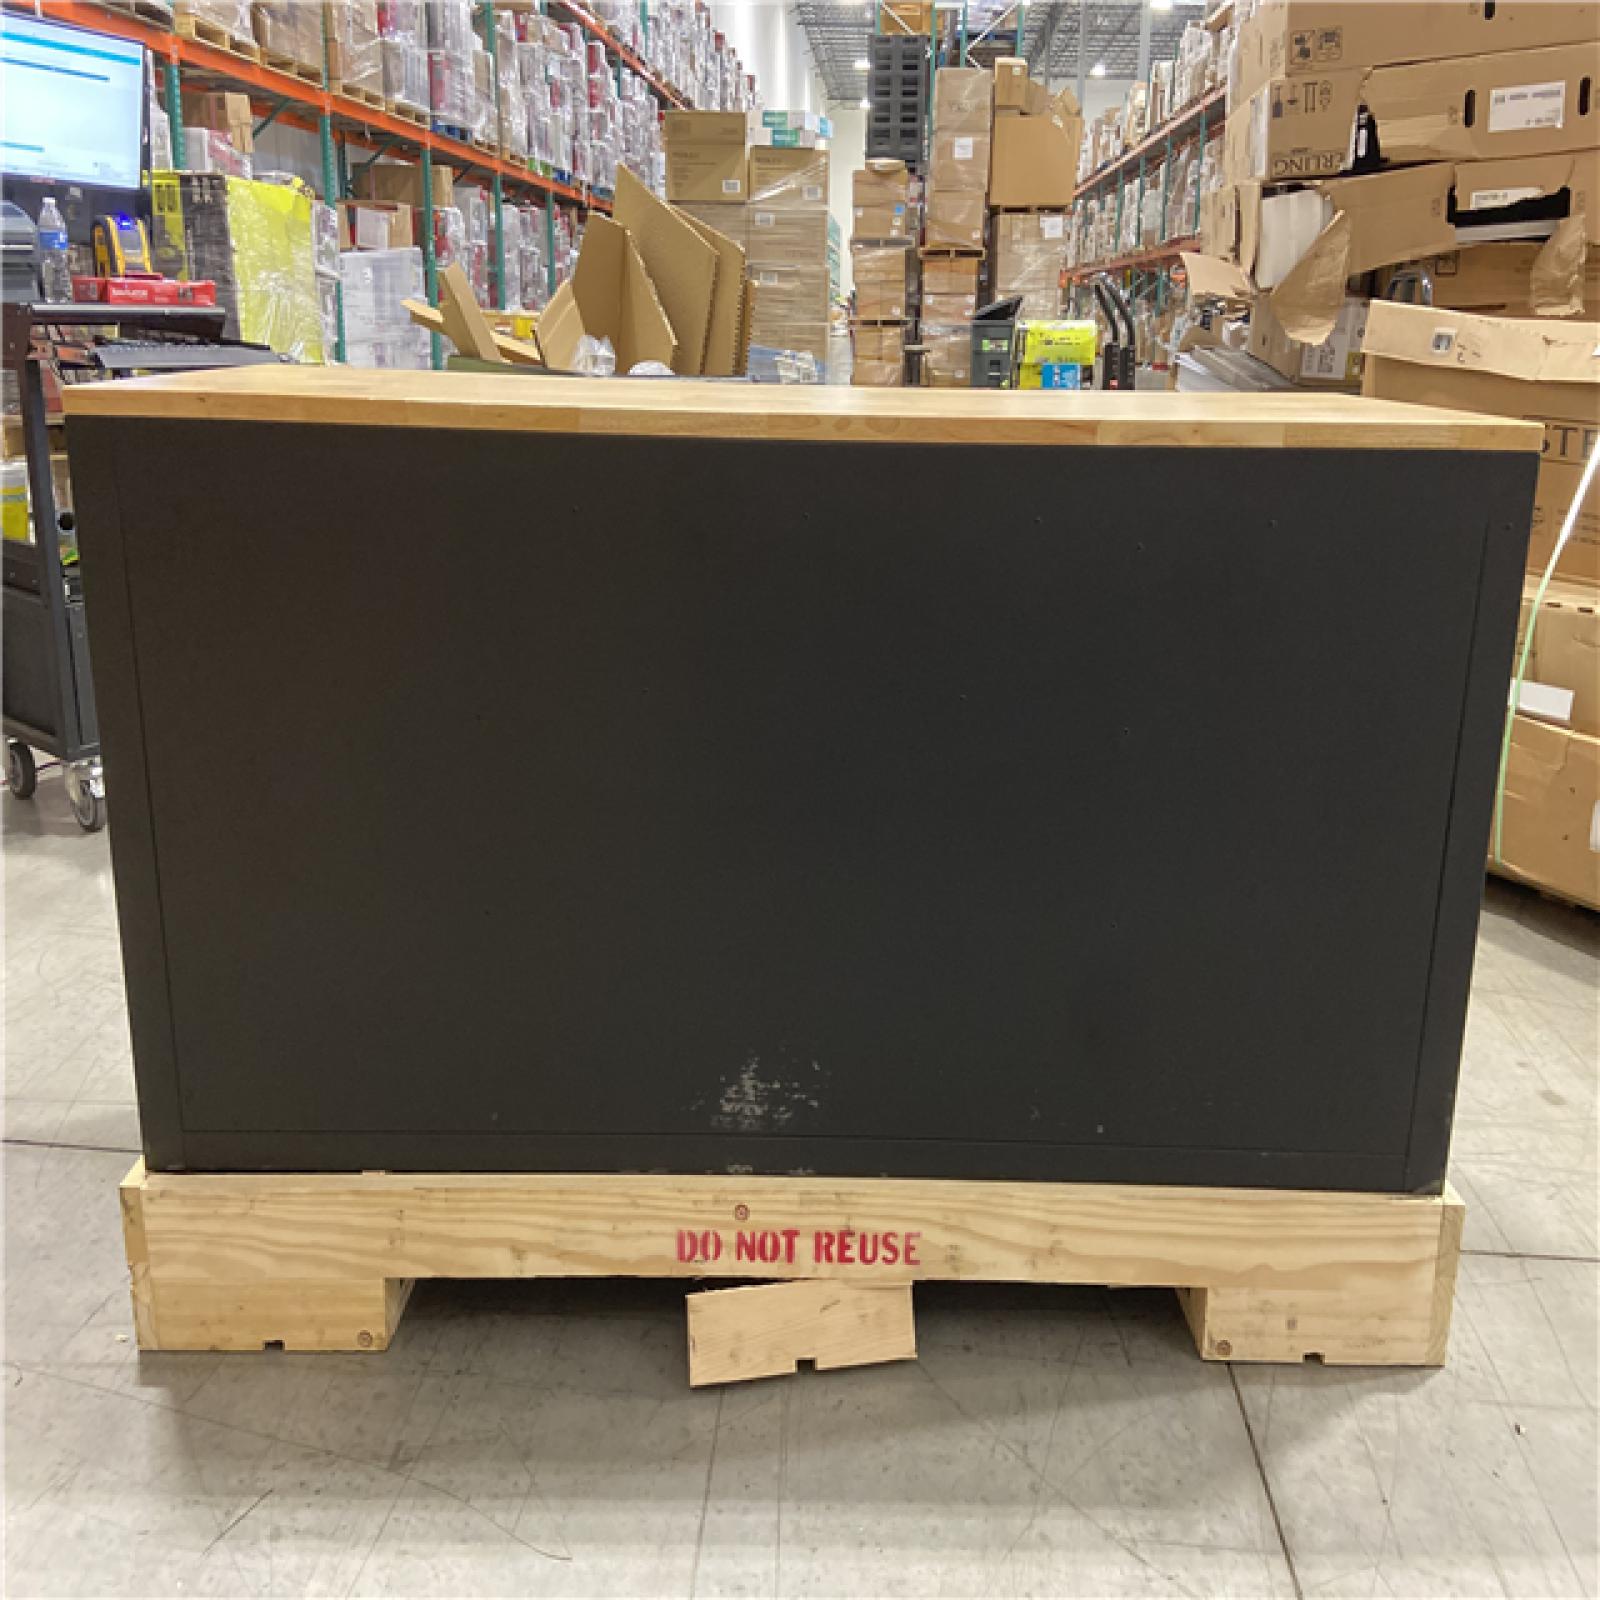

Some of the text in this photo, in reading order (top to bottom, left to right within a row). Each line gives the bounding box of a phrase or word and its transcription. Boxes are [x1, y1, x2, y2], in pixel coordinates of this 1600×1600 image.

[677, 1229, 921, 1265] DO NOT REUSE
